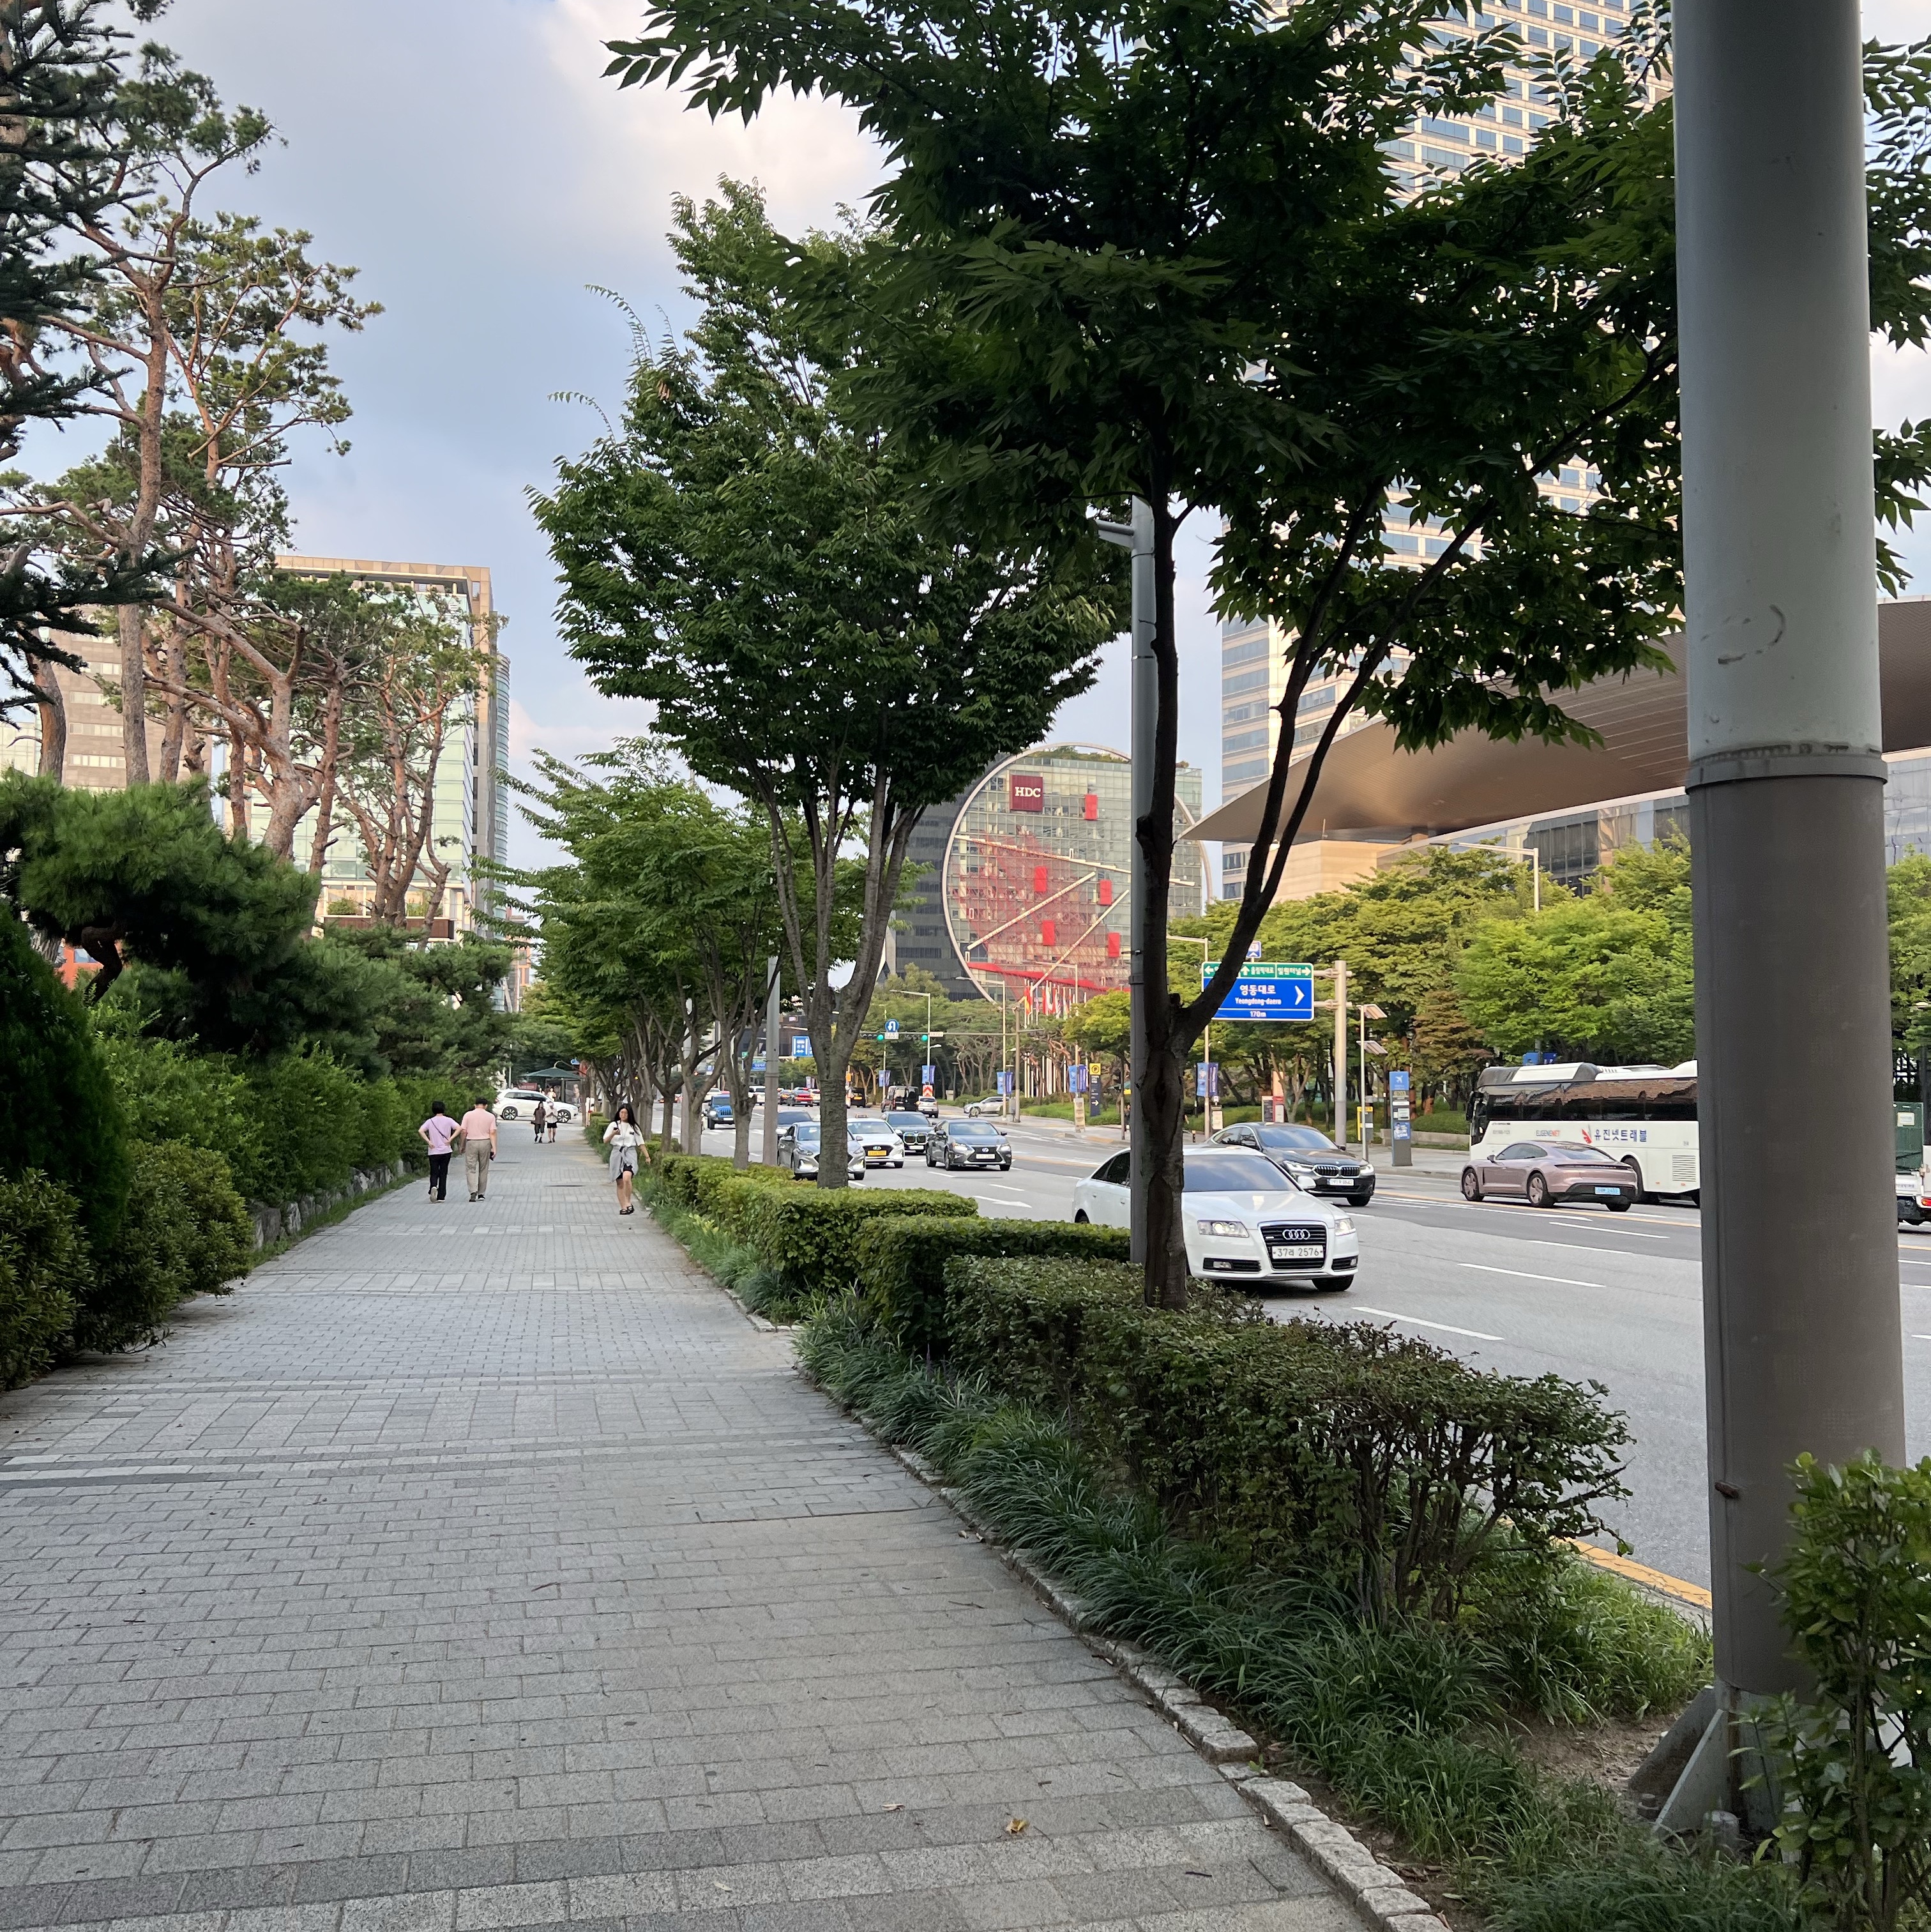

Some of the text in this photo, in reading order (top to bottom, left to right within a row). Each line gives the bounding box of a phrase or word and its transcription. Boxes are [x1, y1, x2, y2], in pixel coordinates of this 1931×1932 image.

[1015, 786, 1041, 798] HDC
[1239, 984, 1276, 996] 영동대로
[1235, 997, 1282, 1006] Yeongdong-daero
[1594, 1129, 1647, 1143] 유진넷트래블
[1298, 1247, 1319, 1256] 2576
